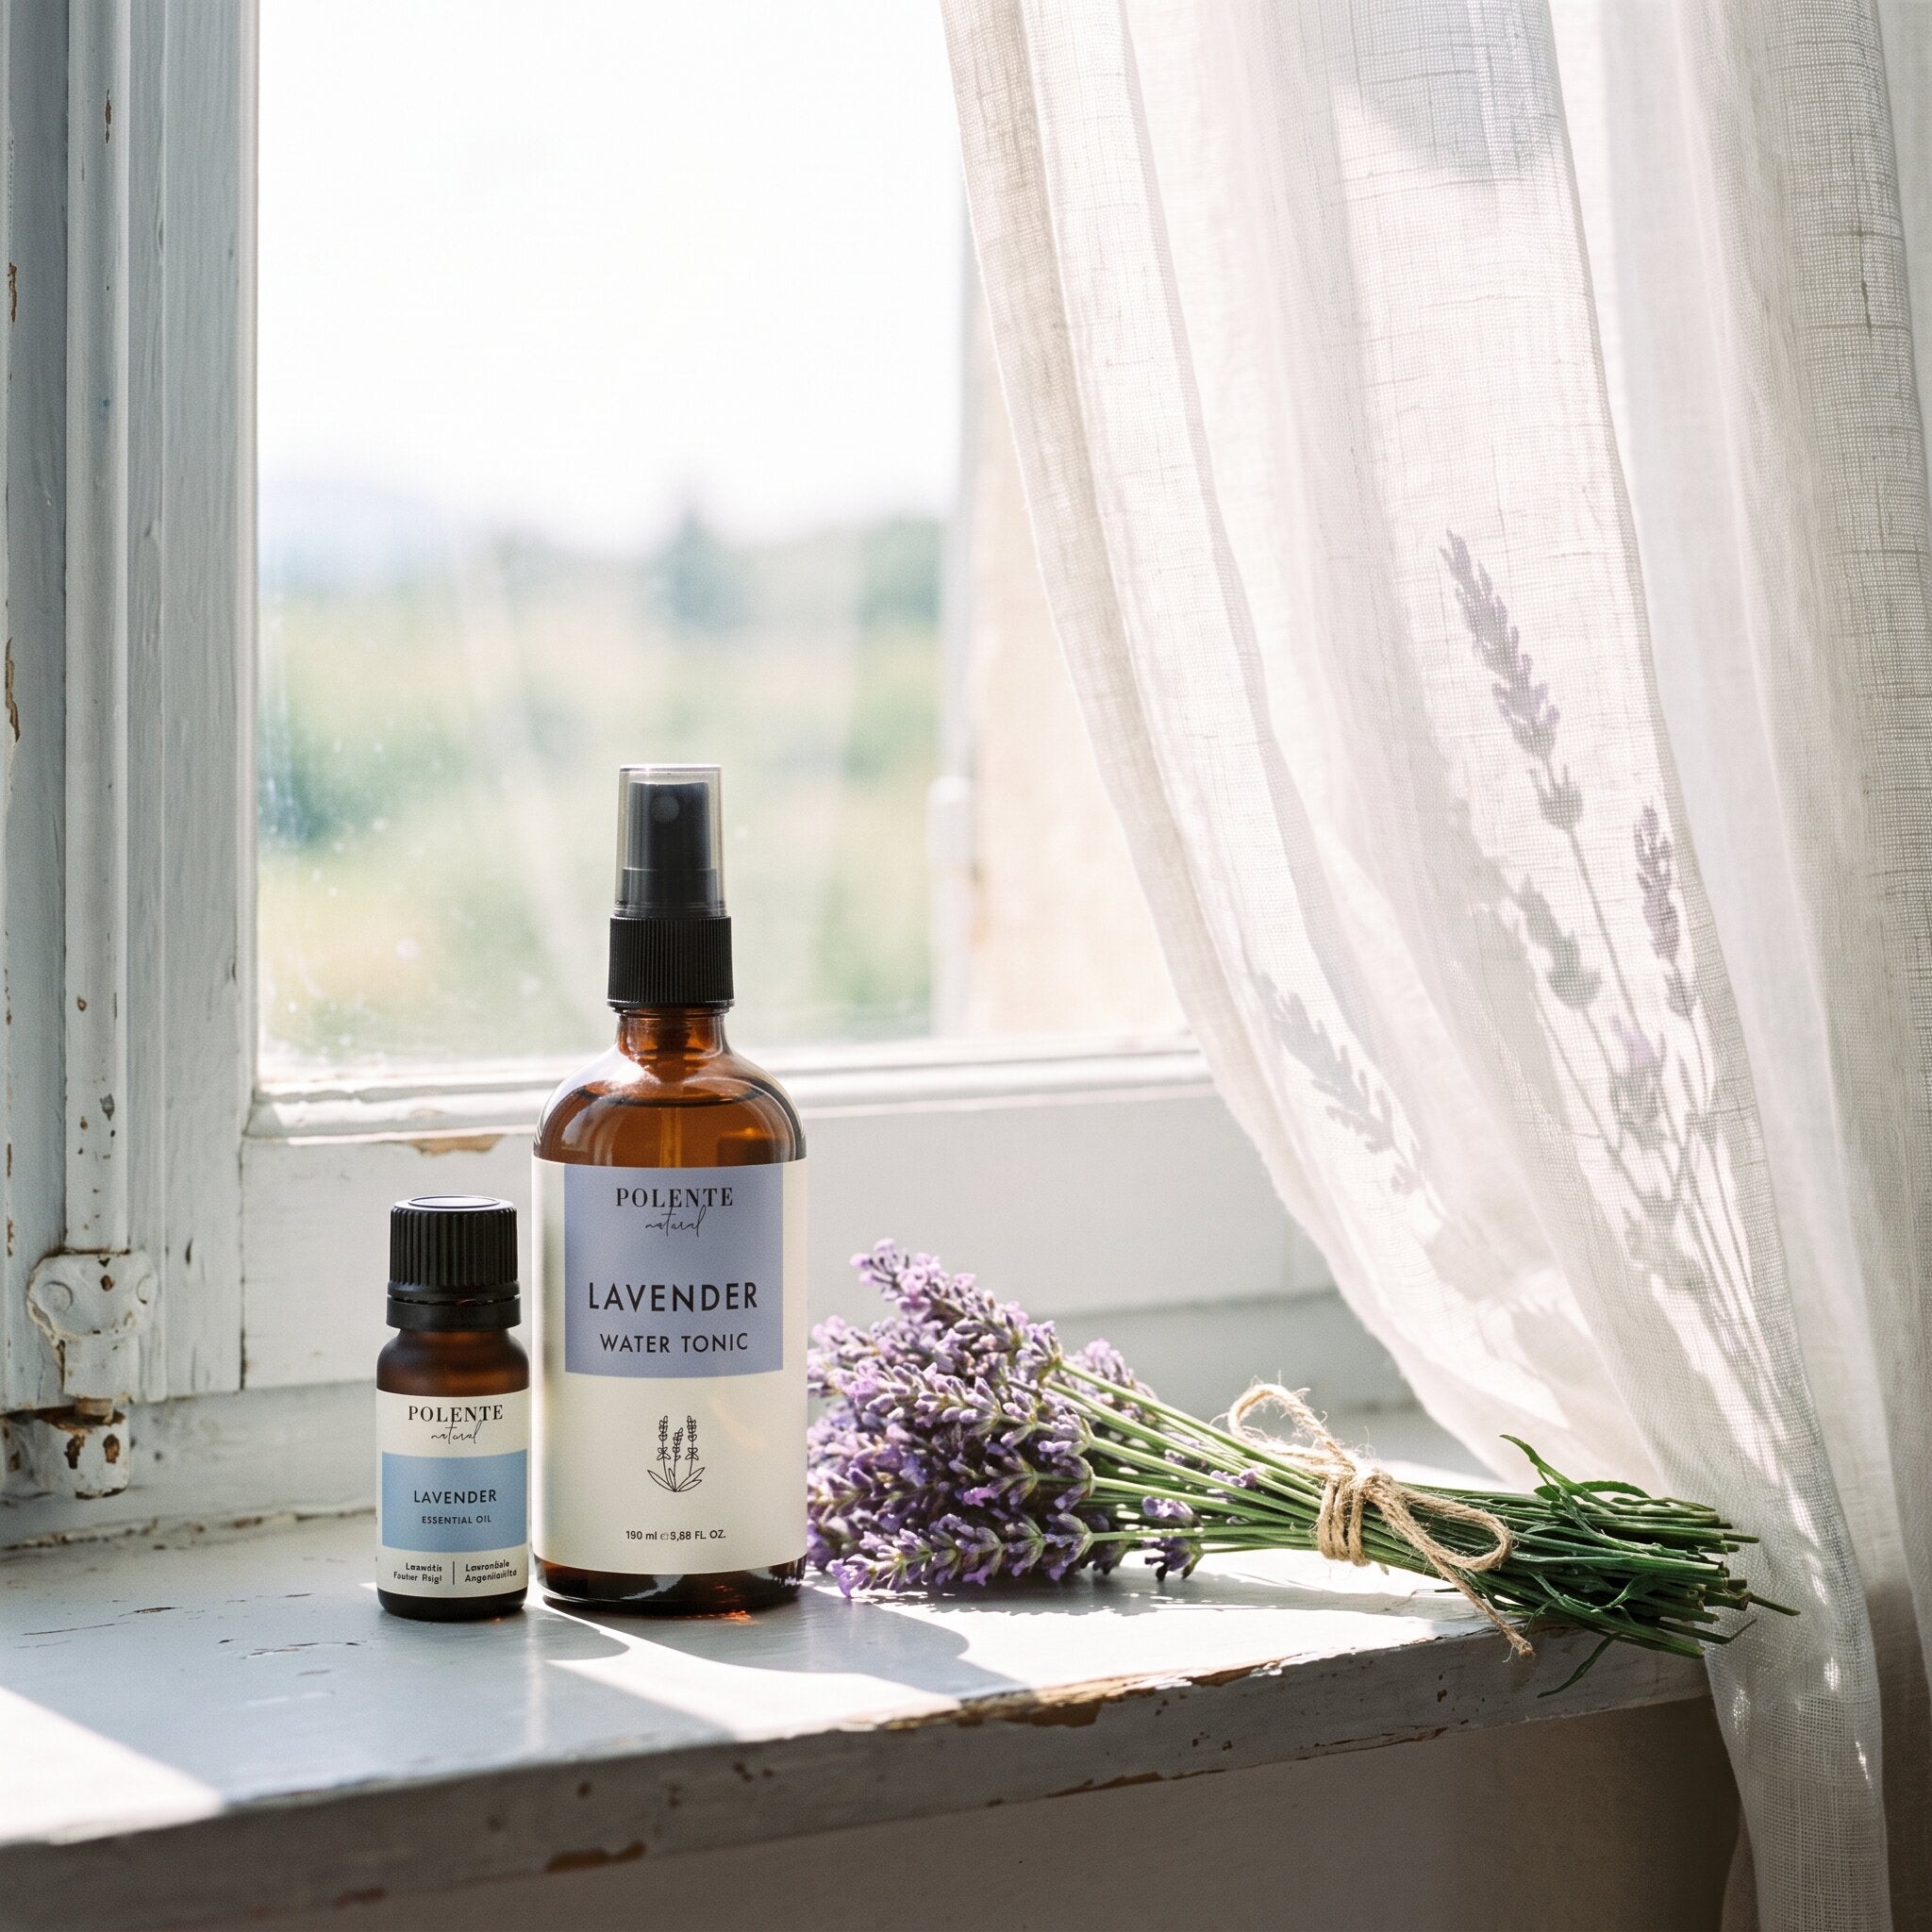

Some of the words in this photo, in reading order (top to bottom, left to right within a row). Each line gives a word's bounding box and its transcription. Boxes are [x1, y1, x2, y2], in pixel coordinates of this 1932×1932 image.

[616, 1188, 734, 1208] POLENTE
[589, 1282, 758, 1312] LAVENDER
[600, 1333, 671, 1353] WATER
[681, 1332, 748, 1353] TONIC
[408, 1405, 503, 1423] POLENTE
[414, 1489, 497, 1505] LAVENDER
[422, 1515, 473, 1524] ESSENTIAL
[476, 1514, 491, 1524] OIL
[645, 1531, 658, 1541] ml
[709, 1529, 726, 1540] OZ.
